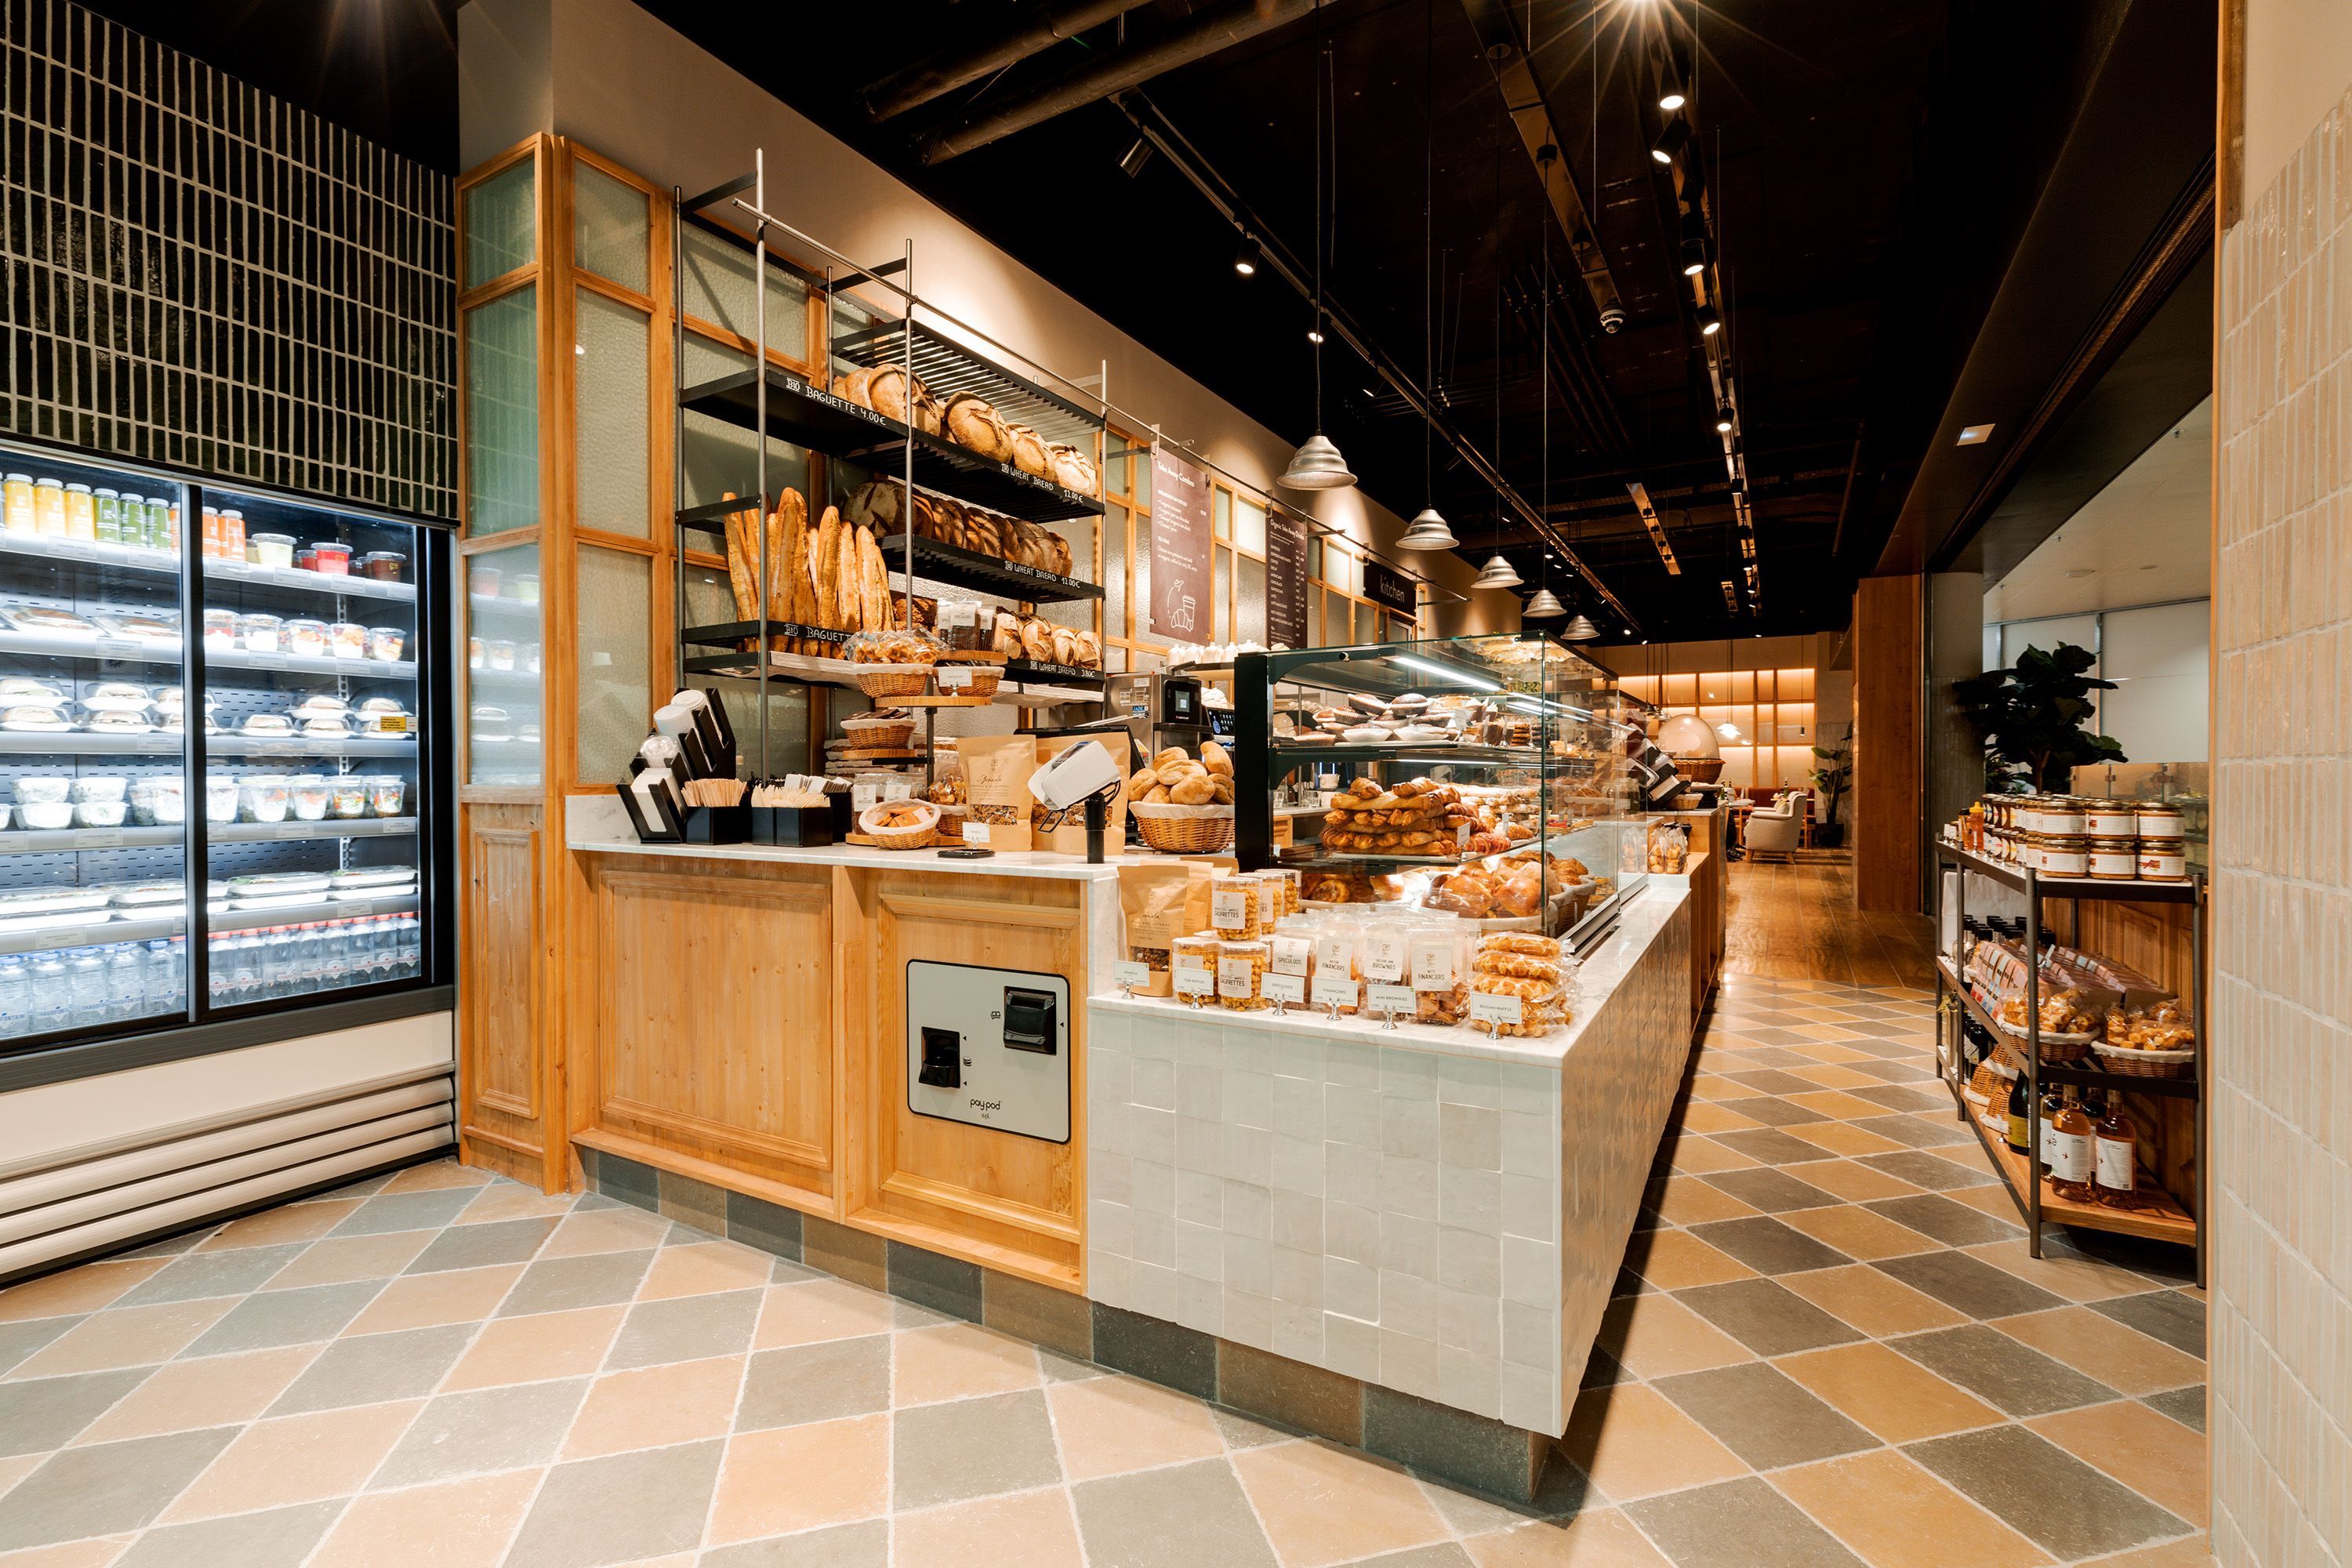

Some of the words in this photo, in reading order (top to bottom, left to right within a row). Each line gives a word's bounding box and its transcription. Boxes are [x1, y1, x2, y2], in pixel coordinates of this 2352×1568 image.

[786, 377, 800, 392] BIO
[805, 386, 856, 414] BAGUETTE
[860, 407, 887, 426] 4.00€
[1010, 466, 1029, 481] WHEAT
[1033, 476, 1054, 491] BREAD
[1158, 461, 1167, 474] Take
[1167, 466, 1178, 481] Away
[1178, 472, 1195, 487] Combos
[1270, 518, 1282, 530] Organic
[1014, 564, 1034, 577] WHEAT
[1036, 569, 1057, 582] BREAD
[1380, 573, 1405, 603] kitchen
[784, 623, 798, 637] BIO
[806, 626, 852, 641] BAGUETT
[1039, 663, 1058, 673] WHEAT
[1058, 666, 1076, 676] BREAD
[1277, 956, 1302, 965] SPECULOOS
[1322, 963, 1345, 972] FINANCIERS
[1372, 962, 1396, 971] BROWNIES
